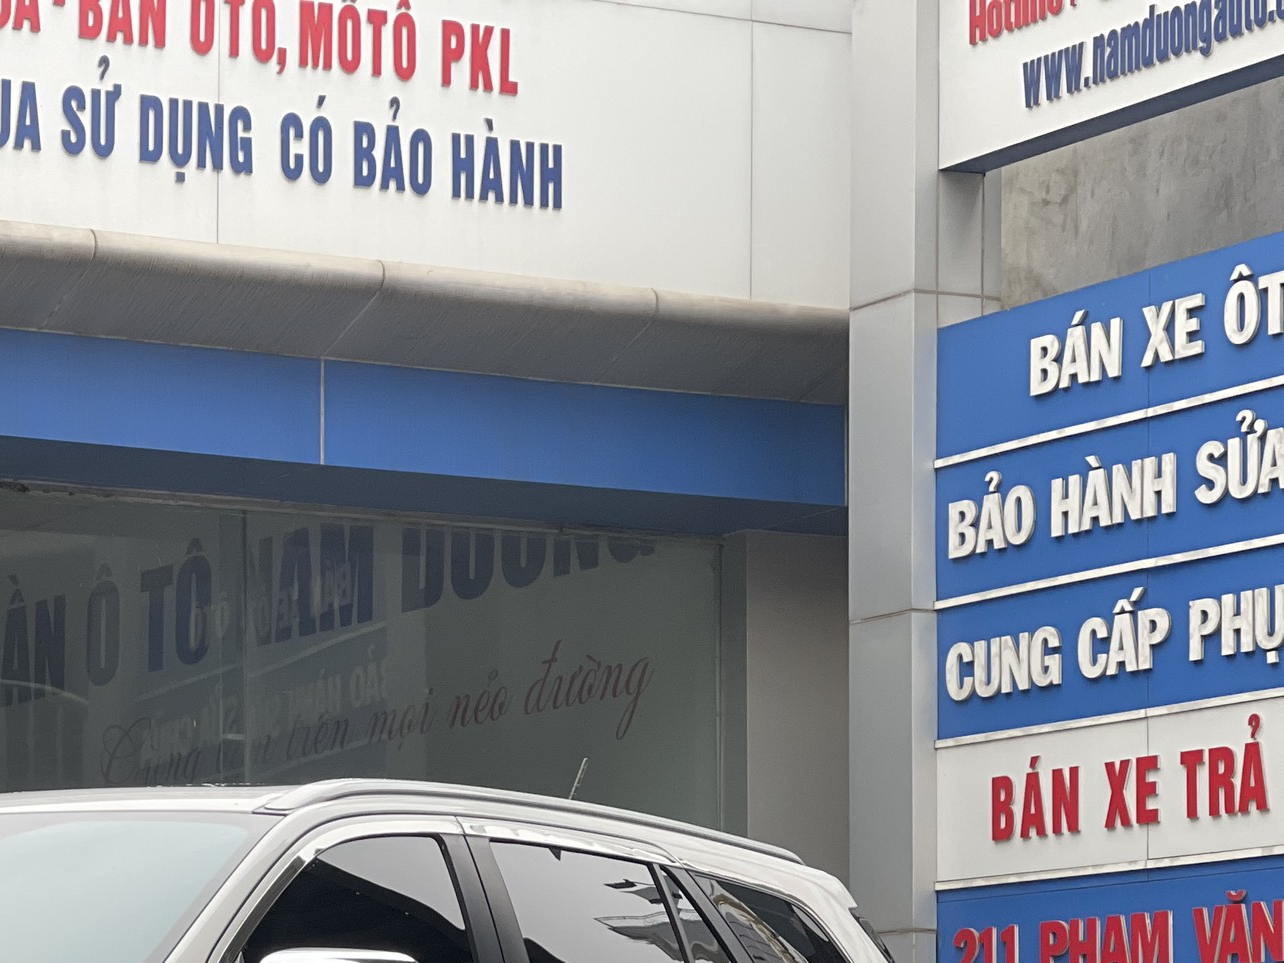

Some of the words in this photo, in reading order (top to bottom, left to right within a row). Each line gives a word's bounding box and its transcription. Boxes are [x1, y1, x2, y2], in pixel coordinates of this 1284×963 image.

[441, 19, 518, 96] PKL
[1022, 0, 1284, 108] www.namduongauto.
[60, 55, 122, 158] SỬ
[139, 94, 253, 184] DỤNG
[280, 95, 333, 185] CÓ
[354, 97, 433, 196] BẢO
[451, 117, 563, 209] HÀNH
[1029, 310, 1124, 398] BÁN
[1141, 293, 1205, 369] XE
[1223, 263, 1284, 346] ÔT
[948, 471, 1036, 560] BẢO
[1051, 455, 1177, 539] HÀNH
[1195, 409, 1284, 504] SỬA
[86, 562, 121, 686] Ô
[140, 537, 213, 673] TÔ
[945, 626, 1062, 701] CUNG
[1078, 587, 1172, 679] CẤP
[1189, 584, 1284, 664] PHỤ
[524, 639, 654, 741] đường
[991, 756, 1081, 843] BÁN
[1104, 755, 1160, 829] XE
[1180, 713, 1270, 820] TRẢ
